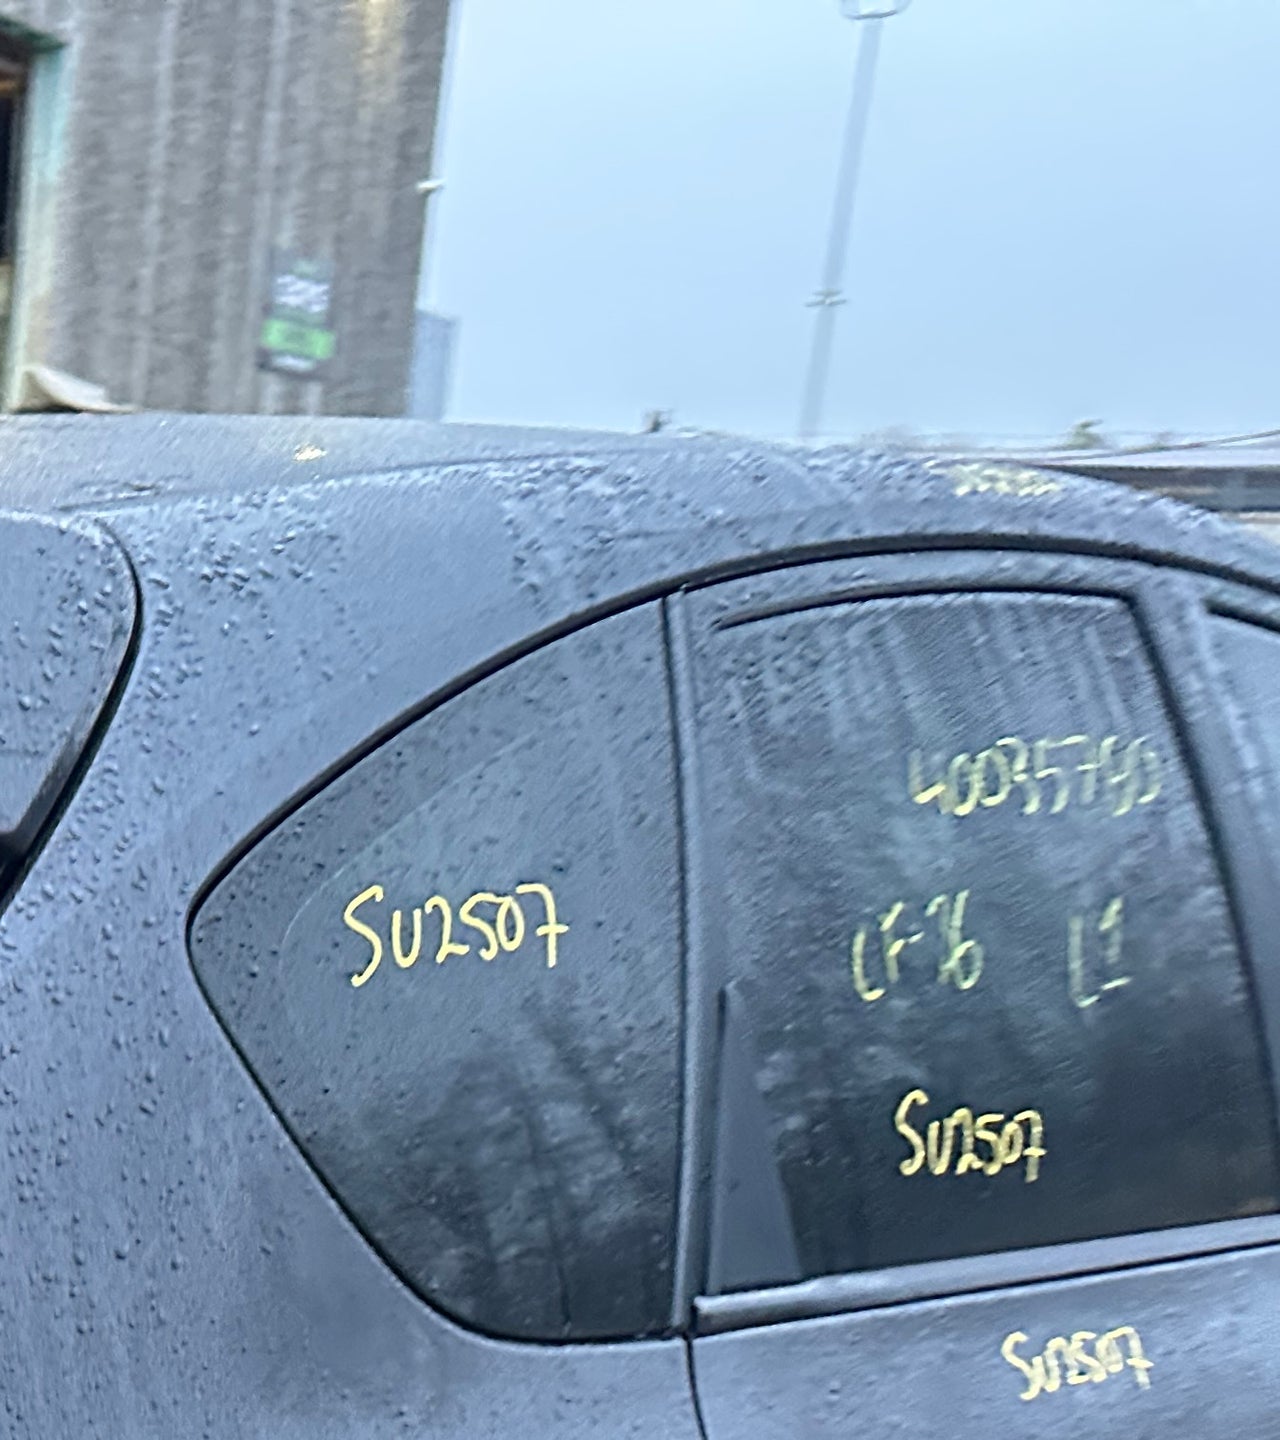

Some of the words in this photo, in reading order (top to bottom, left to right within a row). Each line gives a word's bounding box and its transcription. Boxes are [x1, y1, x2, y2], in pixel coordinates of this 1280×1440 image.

[343, 883, 570, 988] SU2507
[894, 1088, 1048, 1184] SU2507
[1000, 1325, 1155, 1401] SU2507
